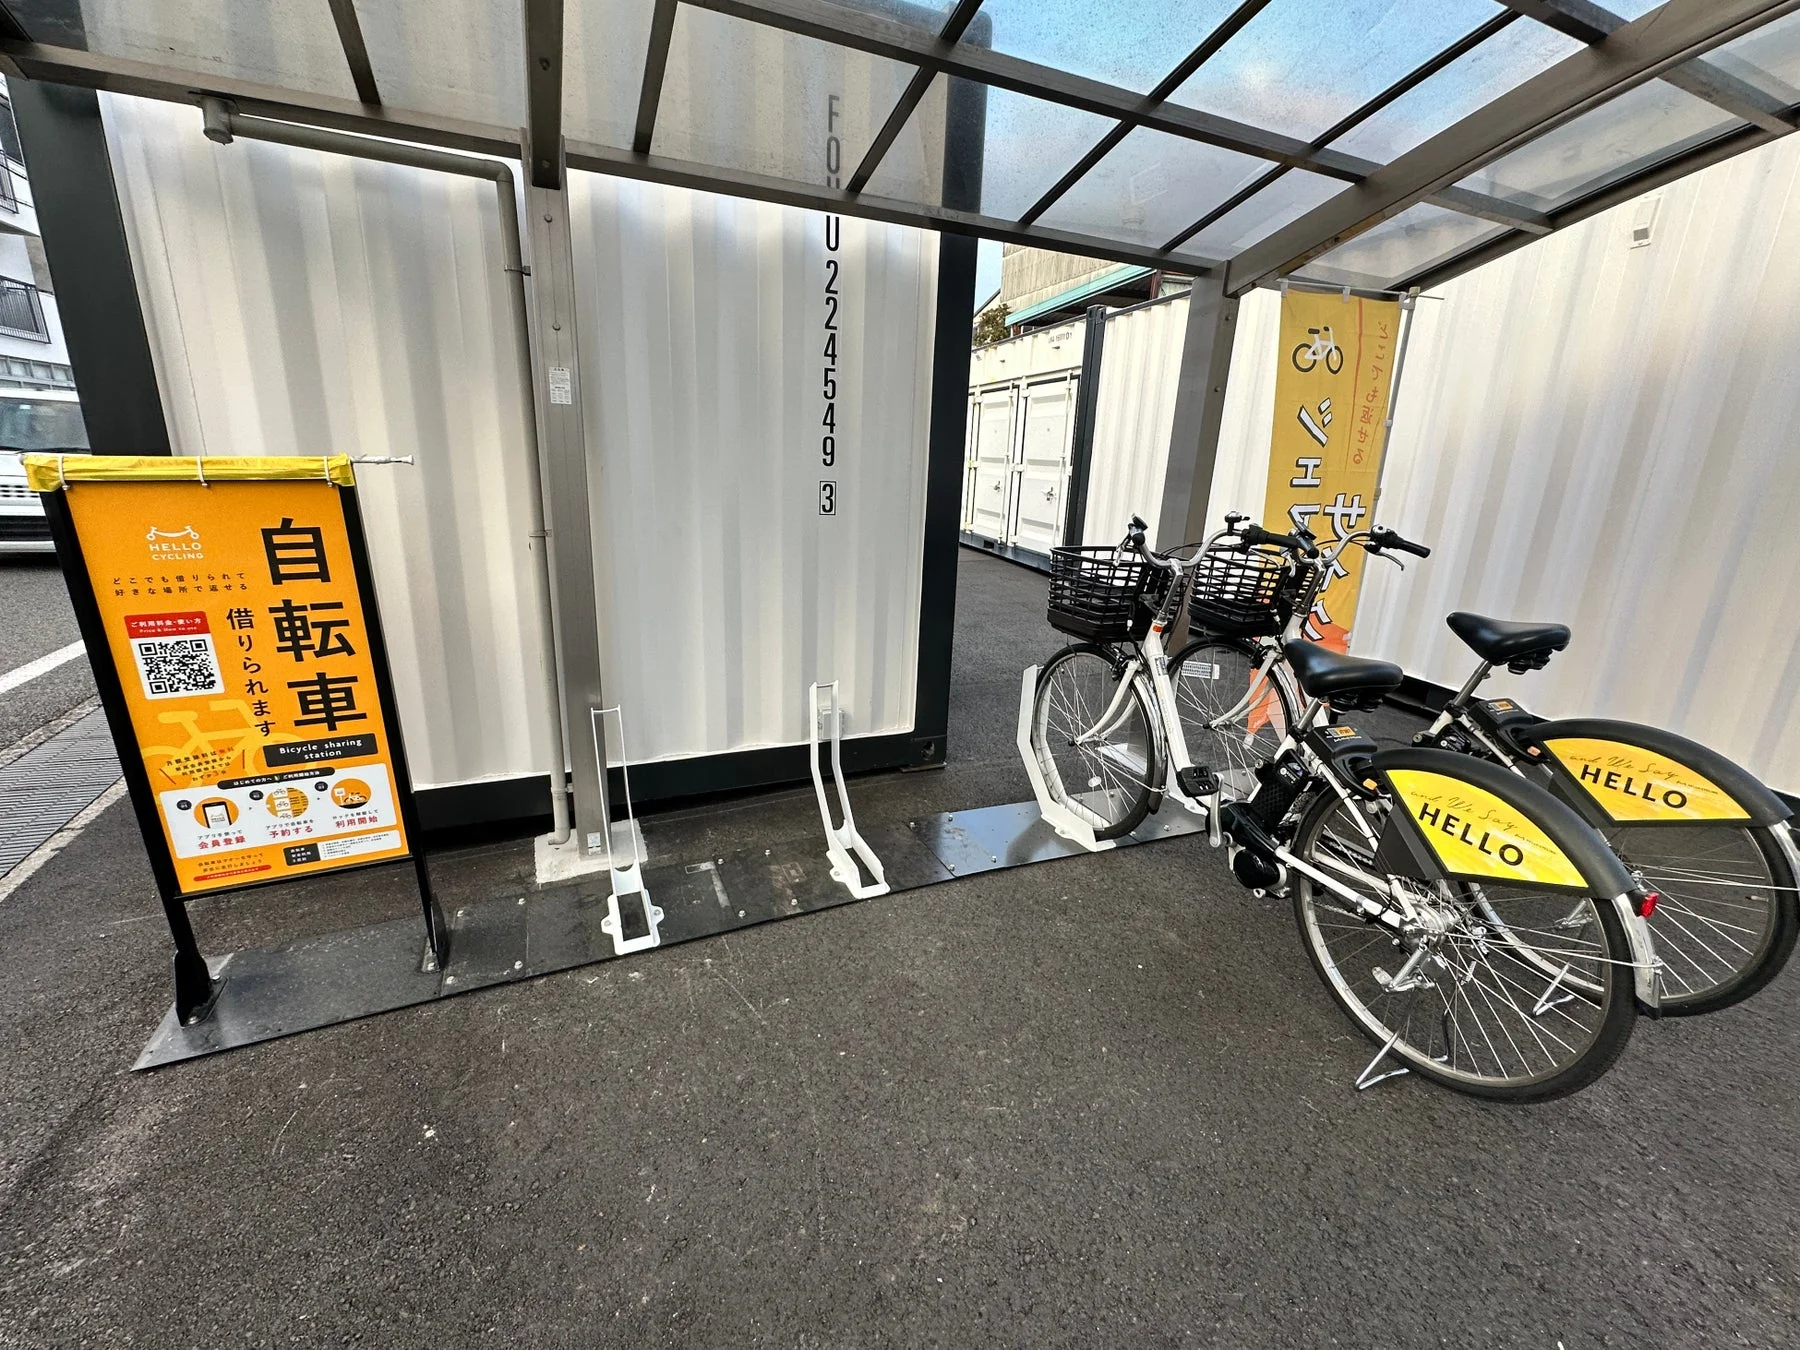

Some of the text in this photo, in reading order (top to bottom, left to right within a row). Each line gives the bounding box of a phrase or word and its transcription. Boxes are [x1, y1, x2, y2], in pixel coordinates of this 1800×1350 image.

[821, 94, 841, 514] FOU 224549 3
[148, 541, 203, 552] HELLO
[151, 552, 204, 561] CYCLING
[113, 572, 246, 585] どこでも借りられて
[114, 583, 248, 597] 好きな場所で返せる
[260, 517, 368, 732] 自転車
[226, 607, 276, 737] 借りられます
[279, 738, 363, 755] Bicycle sharing
[304, 749, 342, 760] station
[1569, 754, 1603, 765] and
[1638, 762, 1680, 780] Say
[1580, 764, 1688, 809] HELLO
[1410, 790, 1519, 831] and We Say
[335, 815, 379, 829] 利用開始
[269, 825, 313, 839] 予約する
[1418, 802, 1524, 867] HELLO
[198, 835, 247, 850] 会員登録
